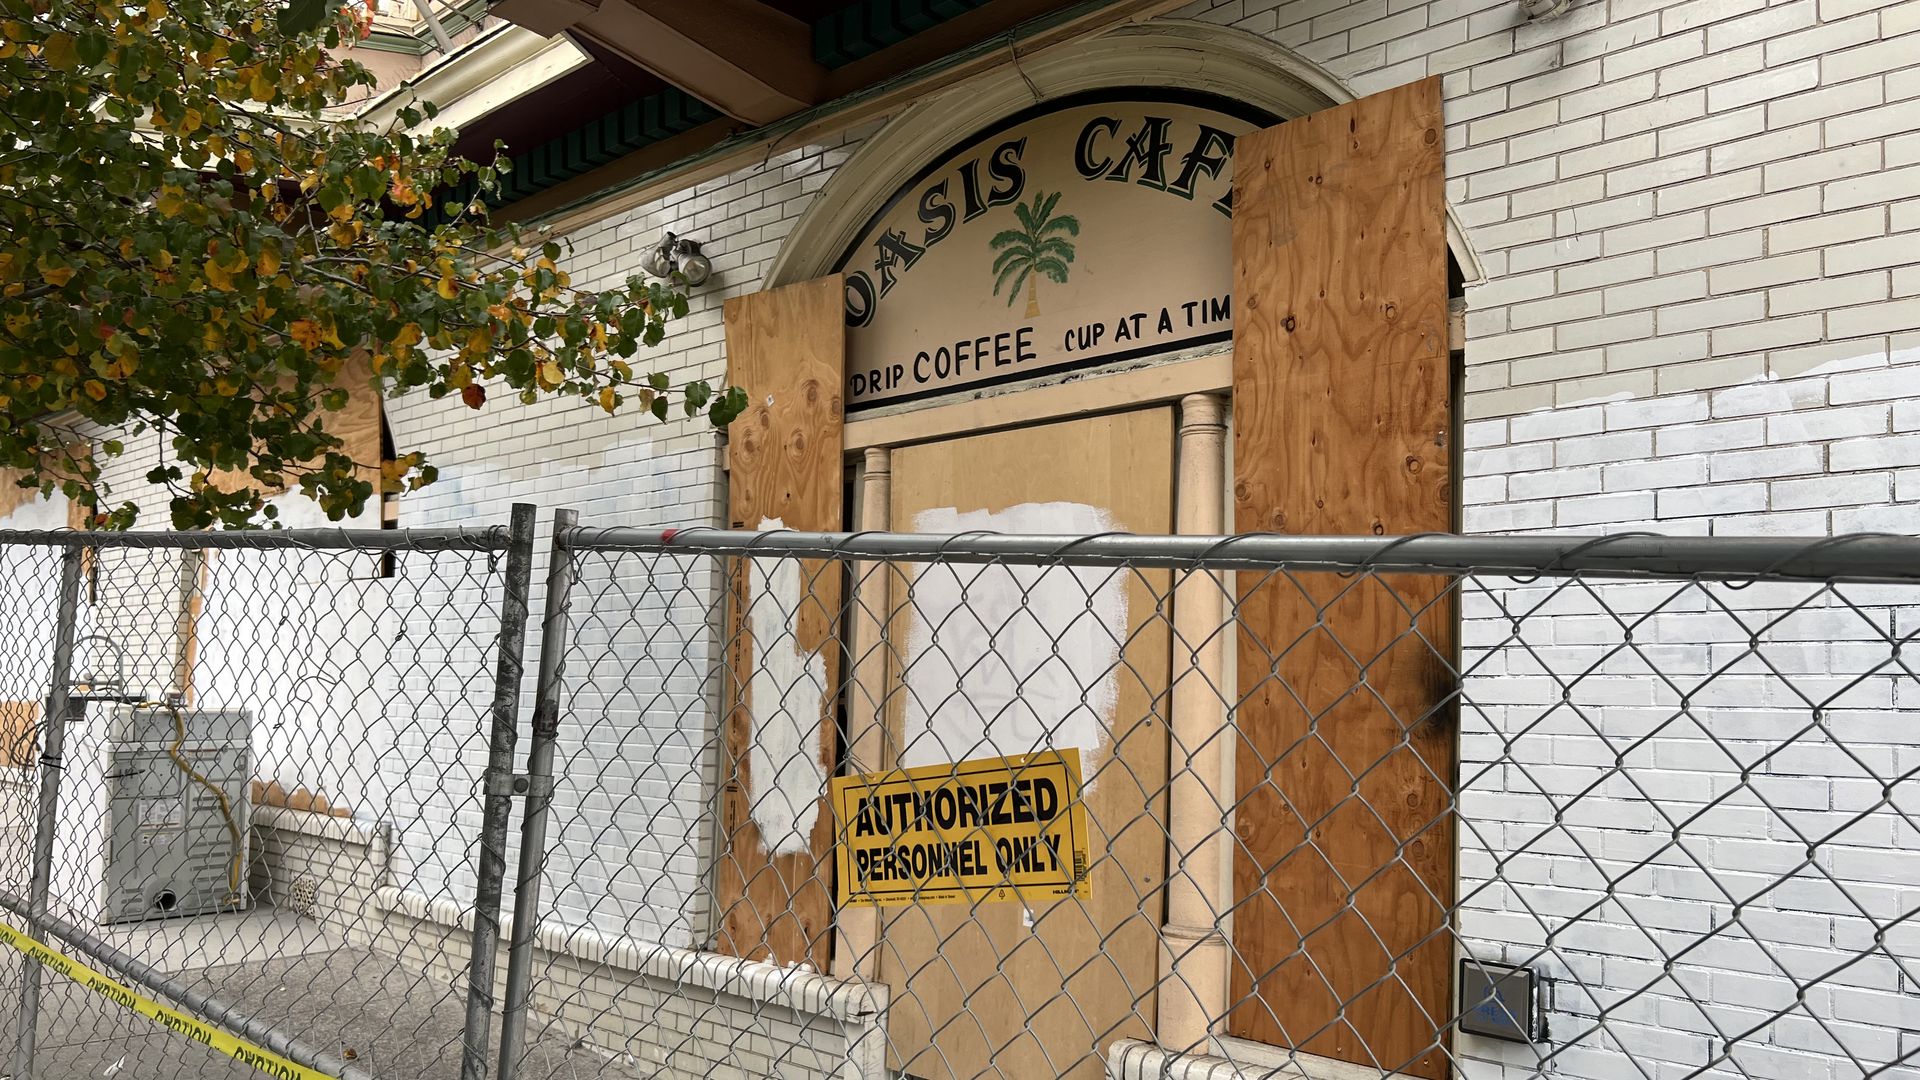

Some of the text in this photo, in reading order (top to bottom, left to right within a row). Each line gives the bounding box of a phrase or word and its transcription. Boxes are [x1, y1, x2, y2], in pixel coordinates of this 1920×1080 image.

[845, 116, 1233, 327] OASIS CAF
[850, 364, 904, 396] DRIP
[913, 326, 1037, 384] COFFEE
[1064, 322, 1105, 352] CUP
[1115, 313, 1147, 343] AT
[1157, 308, 1173, 334] A
[855, 777, 1058, 837] AUTHORIZED
[857, 840, 988, 882] PERSONNEL
[996, 834, 1061, 875] ONLY
